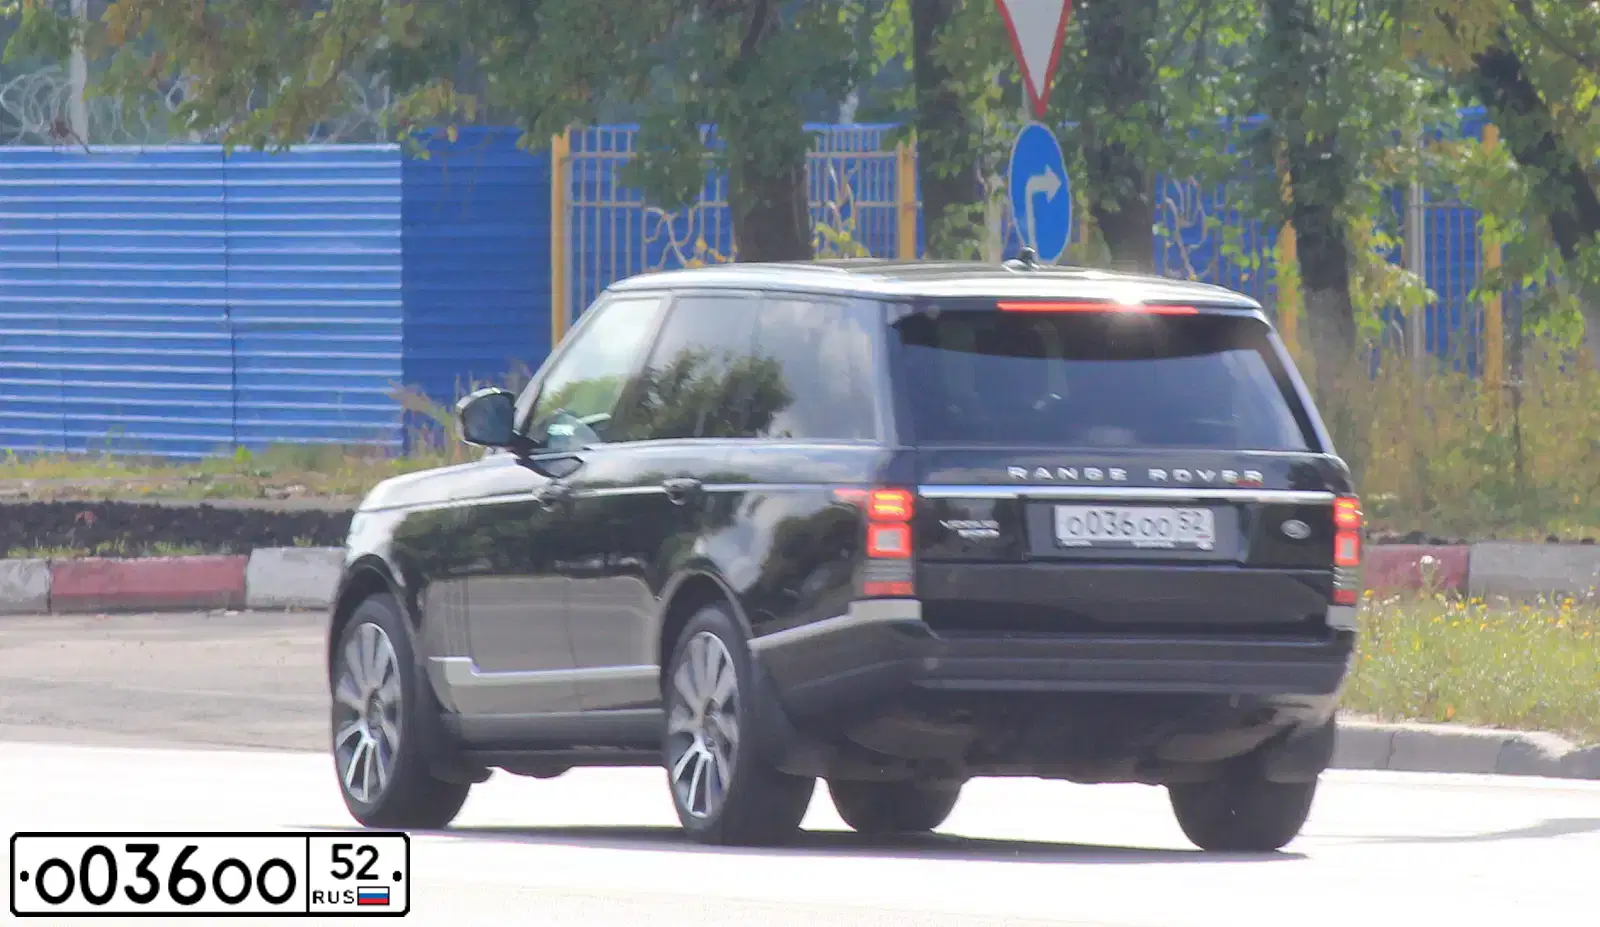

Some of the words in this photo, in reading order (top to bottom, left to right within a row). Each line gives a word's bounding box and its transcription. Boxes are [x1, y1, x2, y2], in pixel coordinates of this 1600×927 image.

[1007, 466, 1128, 481] RANGE
[1148, 467, 1263, 483] ROVER
[1179, 510, 1206, 532] 52
